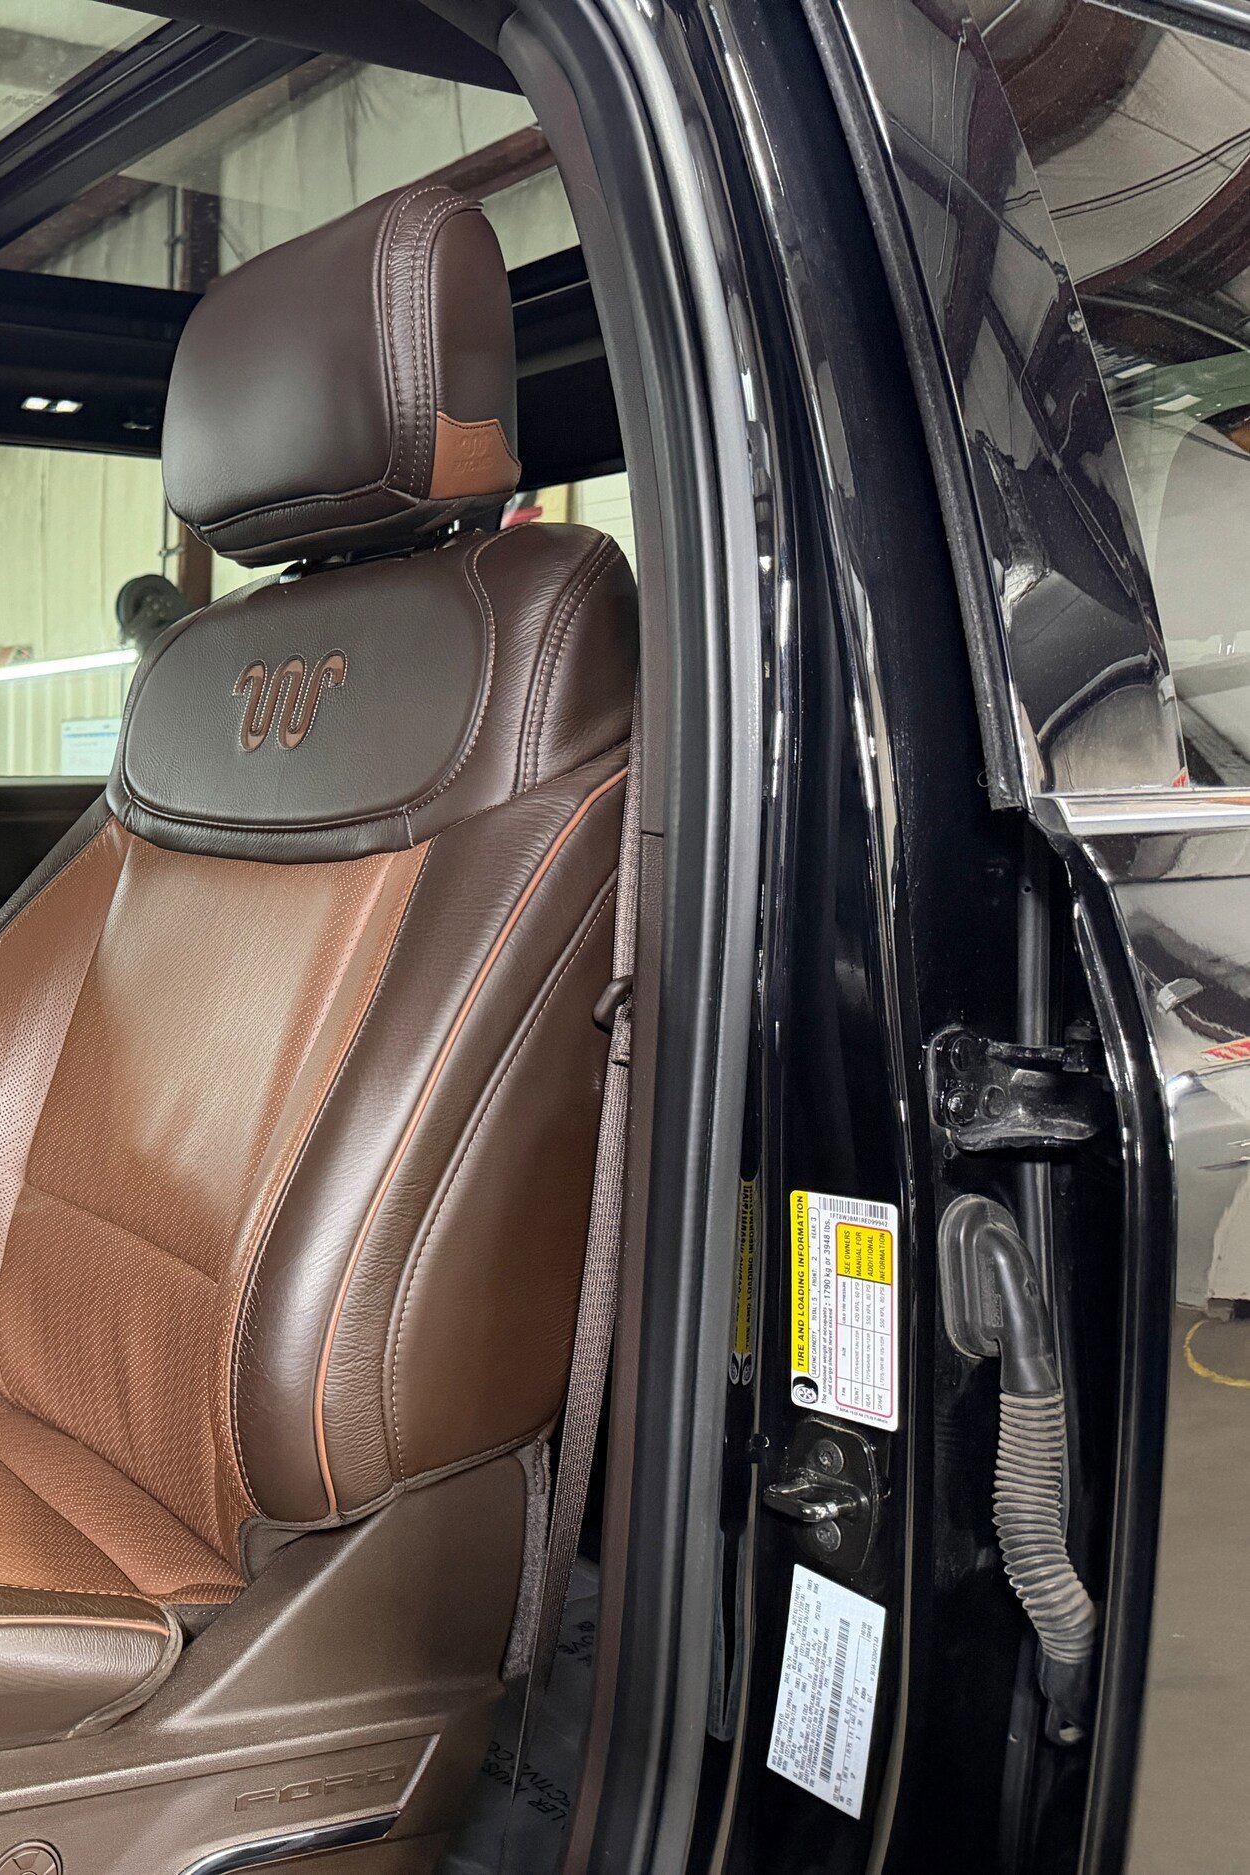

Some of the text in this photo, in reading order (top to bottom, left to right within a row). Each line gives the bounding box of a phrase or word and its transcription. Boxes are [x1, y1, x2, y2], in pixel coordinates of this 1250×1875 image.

[823, 1234, 831, 1255] 3948
[824, 1257, 831, 1266] or
[796, 1195, 805, 1367] TIRE AND LOADING INFORMATION
[823, 1267, 832, 1278] kg
[823, 1279, 831, 1300] 1790
